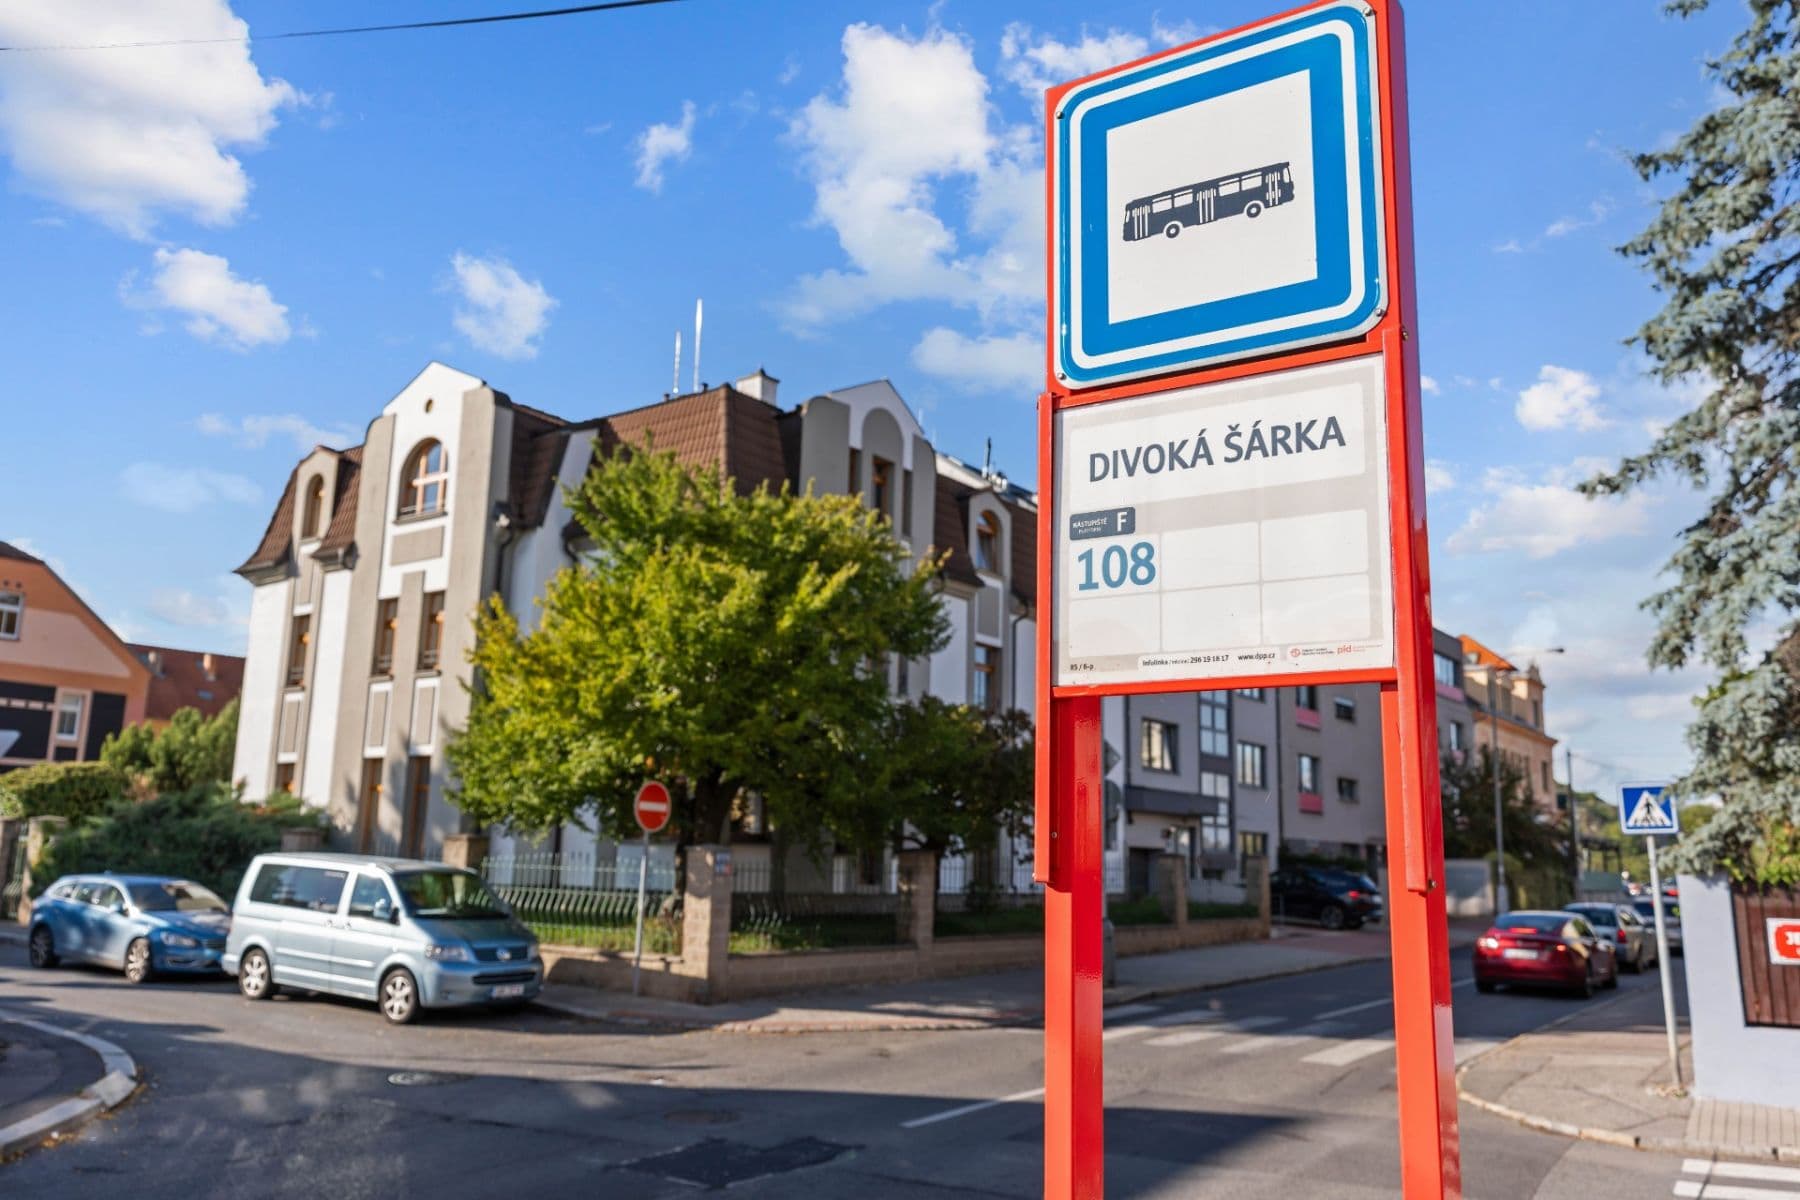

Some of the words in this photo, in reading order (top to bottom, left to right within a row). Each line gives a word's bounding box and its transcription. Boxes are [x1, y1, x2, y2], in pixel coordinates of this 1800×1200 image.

[1089, 428, 1214, 482] DIVOKÁ
[1223, 416, 1346, 463] ŠÁRKA
[1117, 511, 1128, 532] F
[1077, 541, 1156, 591] 108
